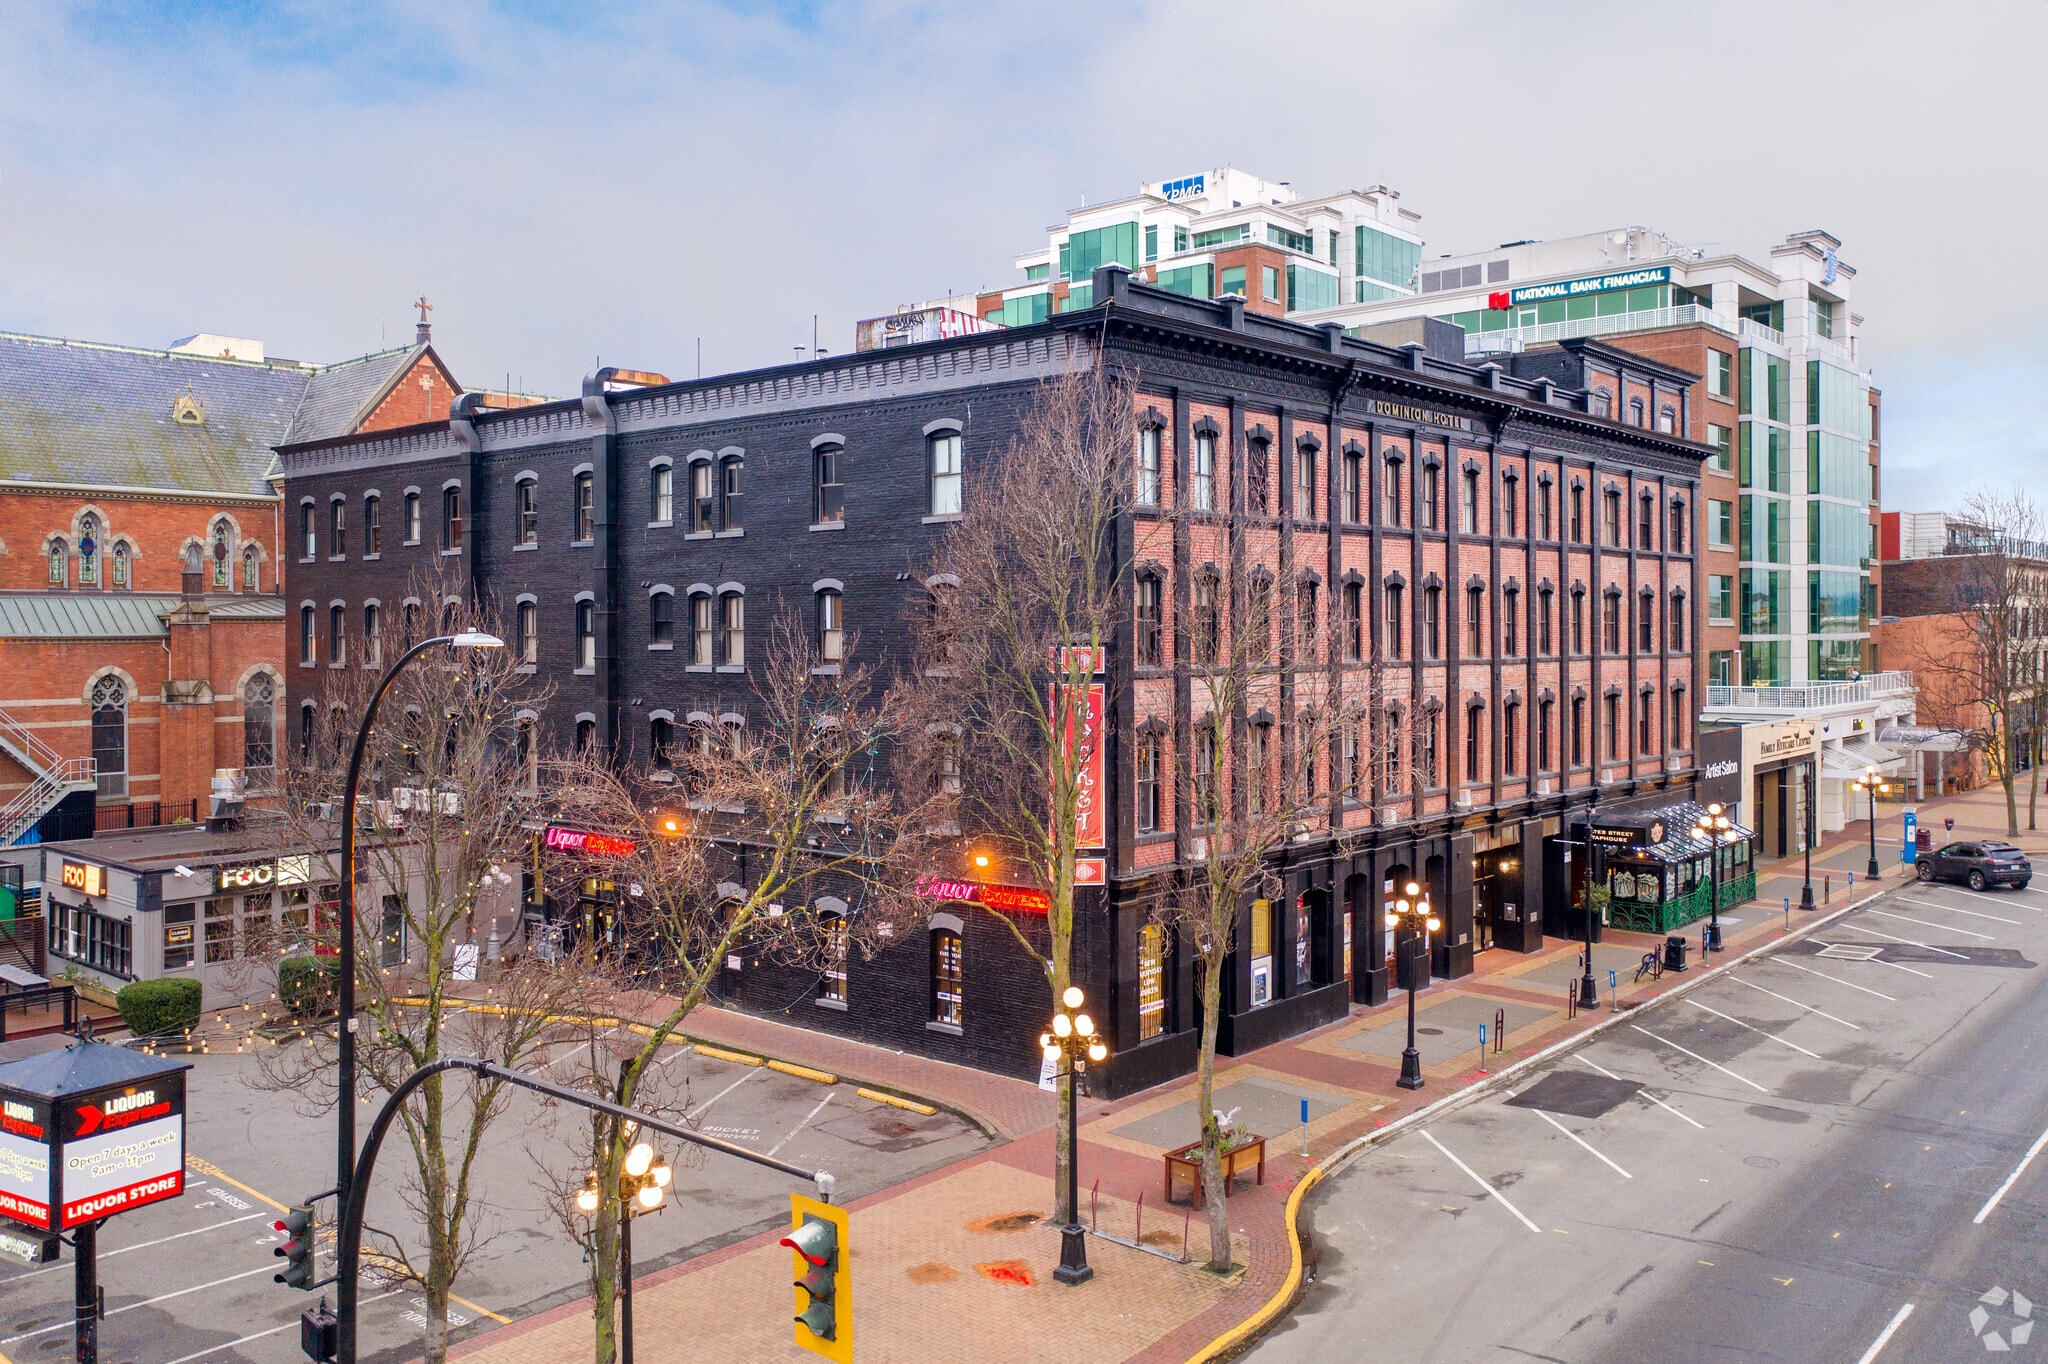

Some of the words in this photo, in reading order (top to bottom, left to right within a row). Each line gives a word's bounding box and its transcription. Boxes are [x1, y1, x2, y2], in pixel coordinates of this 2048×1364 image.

[1162, 184, 1202, 202] KPMG
[1515, 283, 1568, 301] NATIONAL
[1570, 278, 1602, 294] BANK
[1603, 269, 1665, 289] FINANCIAL
[1376, 400, 1428, 422] DOMINION
[1432, 411, 1465, 430] HOTEL
[1704, 762, 1721, 780] Artist
[1721, 759, 1738, 776] Salon
[547, 828, 586, 850] Liquor
[1607, 829, 1634, 837] STREET
[64, 865, 85, 887] FOO
[222, 864, 273, 889] FOO
[4, 1100, 34, 1122] LIQUOR
[105, 1090, 156, 1115] LIQUOR
[2, 1113, 44, 1139] Express
[102, 1101, 171, 1130] Express
[702, 1125, 760, 1135] ROCKET
[68, 1154, 101, 1169] Open
[103, 1149, 111, 1161] 7
[112, 1144, 138, 1157] days
[148, 1131, 177, 1147] week
[91, 1165, 116, 1178] 9am
[126, 1152, 155, 1168] 11pm
[17, 1200, 48, 1221] STORE
[67, 1191, 127, 1220] LIQUOR
[129, 1177, 176, 1201] STORE
